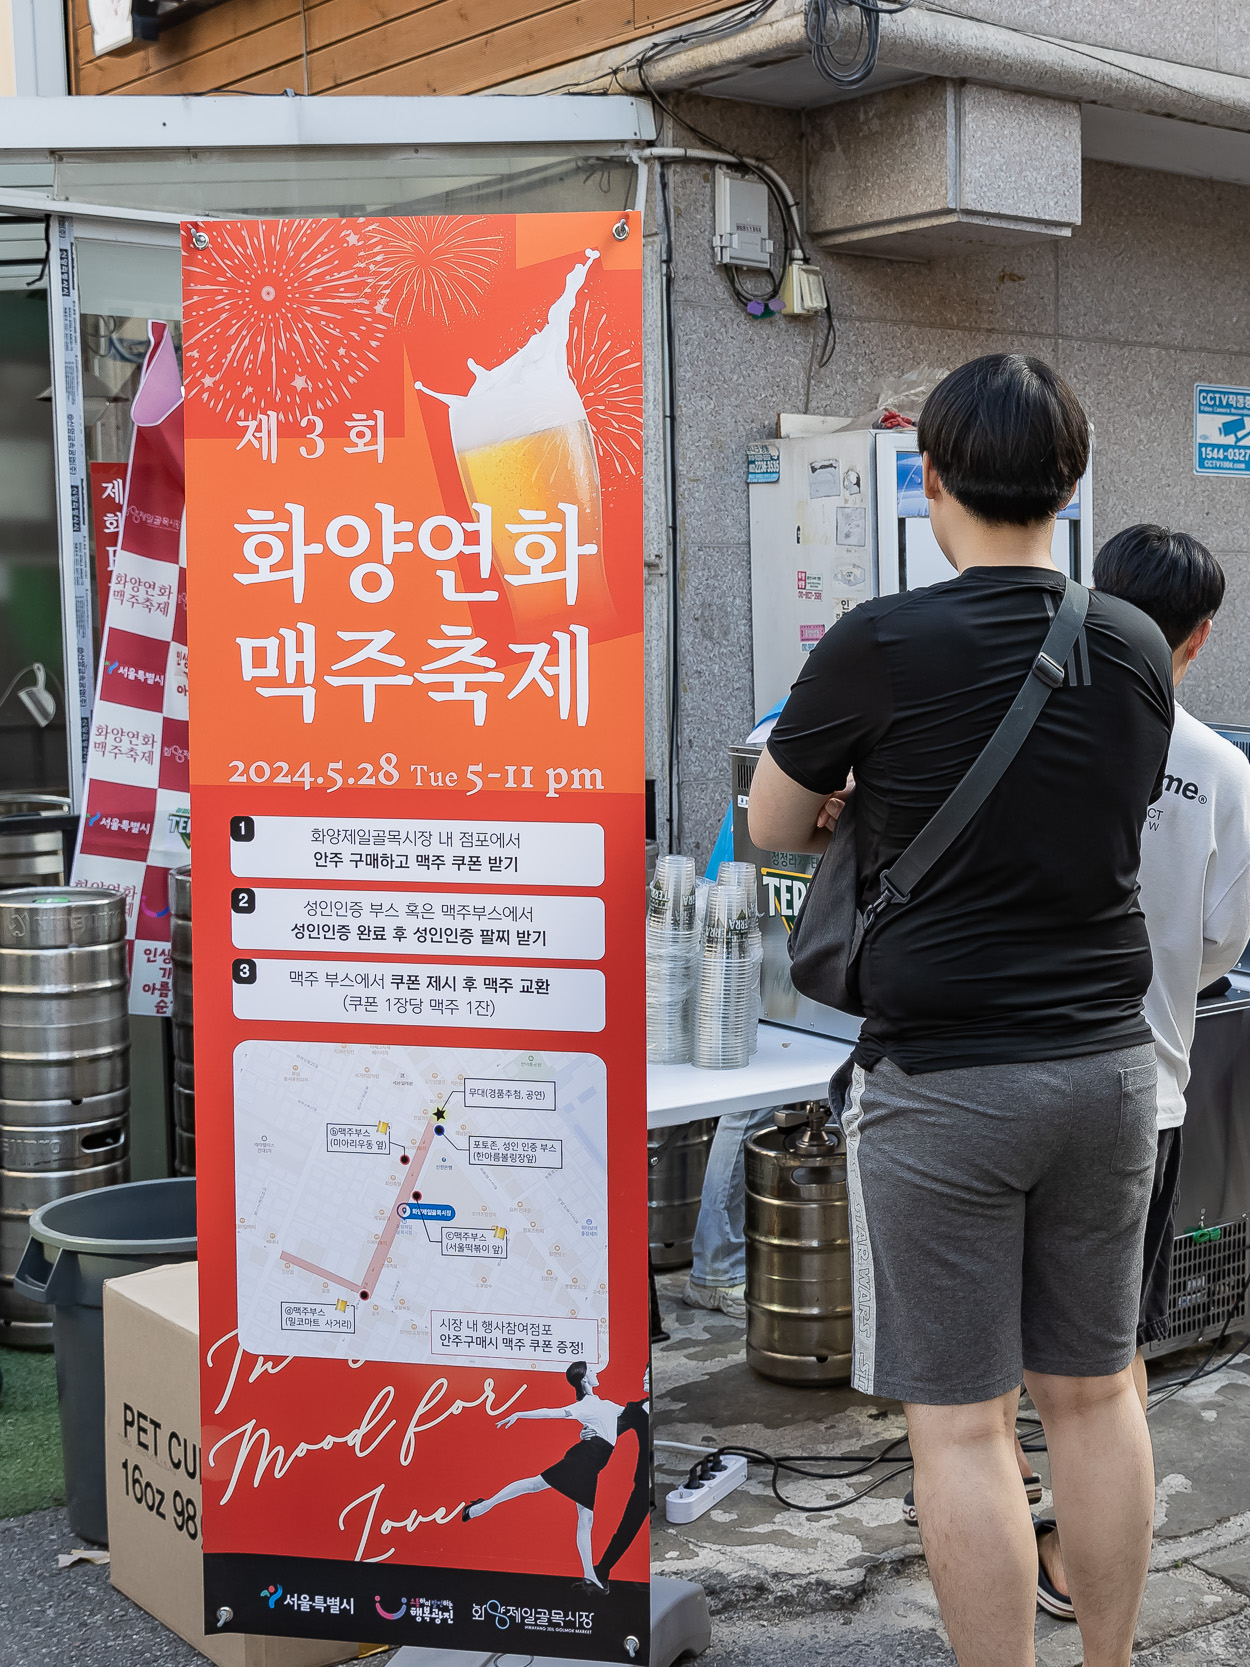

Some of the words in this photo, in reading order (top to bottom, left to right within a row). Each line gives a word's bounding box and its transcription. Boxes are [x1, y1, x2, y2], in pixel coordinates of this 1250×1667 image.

[236, 412, 279, 463] 제
[299, 415, 325, 459] 3
[344, 410, 386, 463] 회
[1201, 447, 1250, 460] 1544-0327
[126, 506, 181, 530] 양제일골목시장
[233, 503, 599, 605] 화양연화
[114, 573, 173, 599] 화양연화
[113, 589, 170, 617] 맥주축제
[118, 666, 165, 686] 서울특별시
[236, 622, 590, 727] 맥주축제
[95, 724, 157, 750] 화양연화
[94, 741, 154, 765] 맥주축제
[229, 753, 400, 793] 2024.5.28
[411, 765, 458, 787] Tue
[467, 763, 534, 796] 5-11
[546, 767, 605, 798] pm
[100, 816, 151, 835] 서울특별시
[238, 821, 246, 835] 1
[311, 828, 432, 847] 화양제일골목시장
[439, 831, 453, 848] 내
[459, 831, 520, 849] 점포에서
[313, 852, 343, 869] 안주
[350, 853, 410, 870] 구매하고
[416, 855, 446, 871] 맥주
[452, 856, 482, 872] 쿠폰
[488, 856, 518, 873] 받기
[239, 894, 249, 907] 2
[763, 876, 810, 916] TER
[304, 900, 364, 918] 성인인증
[370, 902, 400, 919] 부스
[405, 903, 436, 920] 혹은
[441, 904, 533, 923] 맥주부스에서
[291, 923, 352, 942] 성인인증
[357, 925, 387, 941] 완료
[393, 926, 407, 942] 후
[413, 927, 475, 945] 성인인증
[480, 929, 510, 946] 팔찌
[516, 930, 546, 947] 받기
[239, 963, 250, 977] 3
[289, 970, 319, 988] 맥주
[325, 972, 385, 990] 부스에서
[390, 974, 420, 991] 쿠폰
[426, 976, 456, 993] 제시
[462, 976, 477, 993] 후
[483, 977, 513, 994] 맥주
[519, 979, 550, 995] 교환
[343, 995, 378, 1013] (쿠폰
[385, 997, 424, 1015] 1장당
[429, 999, 460, 1016] 맥주
[466, 1000, 496, 1018] 1잔)
[469, 1088, 524, 1100] 무대(경품추첨,
[526, 1090, 546, 1101] 공연)
[330, 1139, 373, 1150] (미아리우동
[376, 1140, 387, 1151] 옆)
[473, 1140, 500, 1151] 포토존,
[503, 1142, 519, 1152] 성인
[521, 1143, 538, 1153] 인증
[540, 1144, 557, 1153] 부스
[473, 1151, 537, 1164] (한아름볼링장앞)
[446, 1242, 490, 1254] (서울떡볶이
[492, 1244, 503, 1255] 앞)
[857, 1268, 872, 1339] WARS
[286, 1317, 320, 1327] (밀코마트
[325, 1319, 352, 1329] 사거리)
[440, 1318, 463, 1332] 시장
[466, 1319, 478, 1333] 내
[482, 1320, 553, 1336] 행사참여점포
[440, 1334, 498, 1350] 안주구매시
[502, 1337, 526, 1351] 맥주
[529, 1340, 553, 1353] 쿠폰
[556, 1340, 584, 1355] 증정!
[123, 1402, 162, 1457] PET
[208, 1385, 397, 1506] Mood
[400, 1377, 528, 1467] for
[122, 1457, 167, 1521] 16oz
[173, 1489, 203, 1541] 98
[338, 1483, 466, 1563] Love
[284, 1593, 355, 1615] 서울특별시
[472, 1599, 595, 1630] 화양제일골목시장
[410, 1607, 454, 1624] 행복광진
